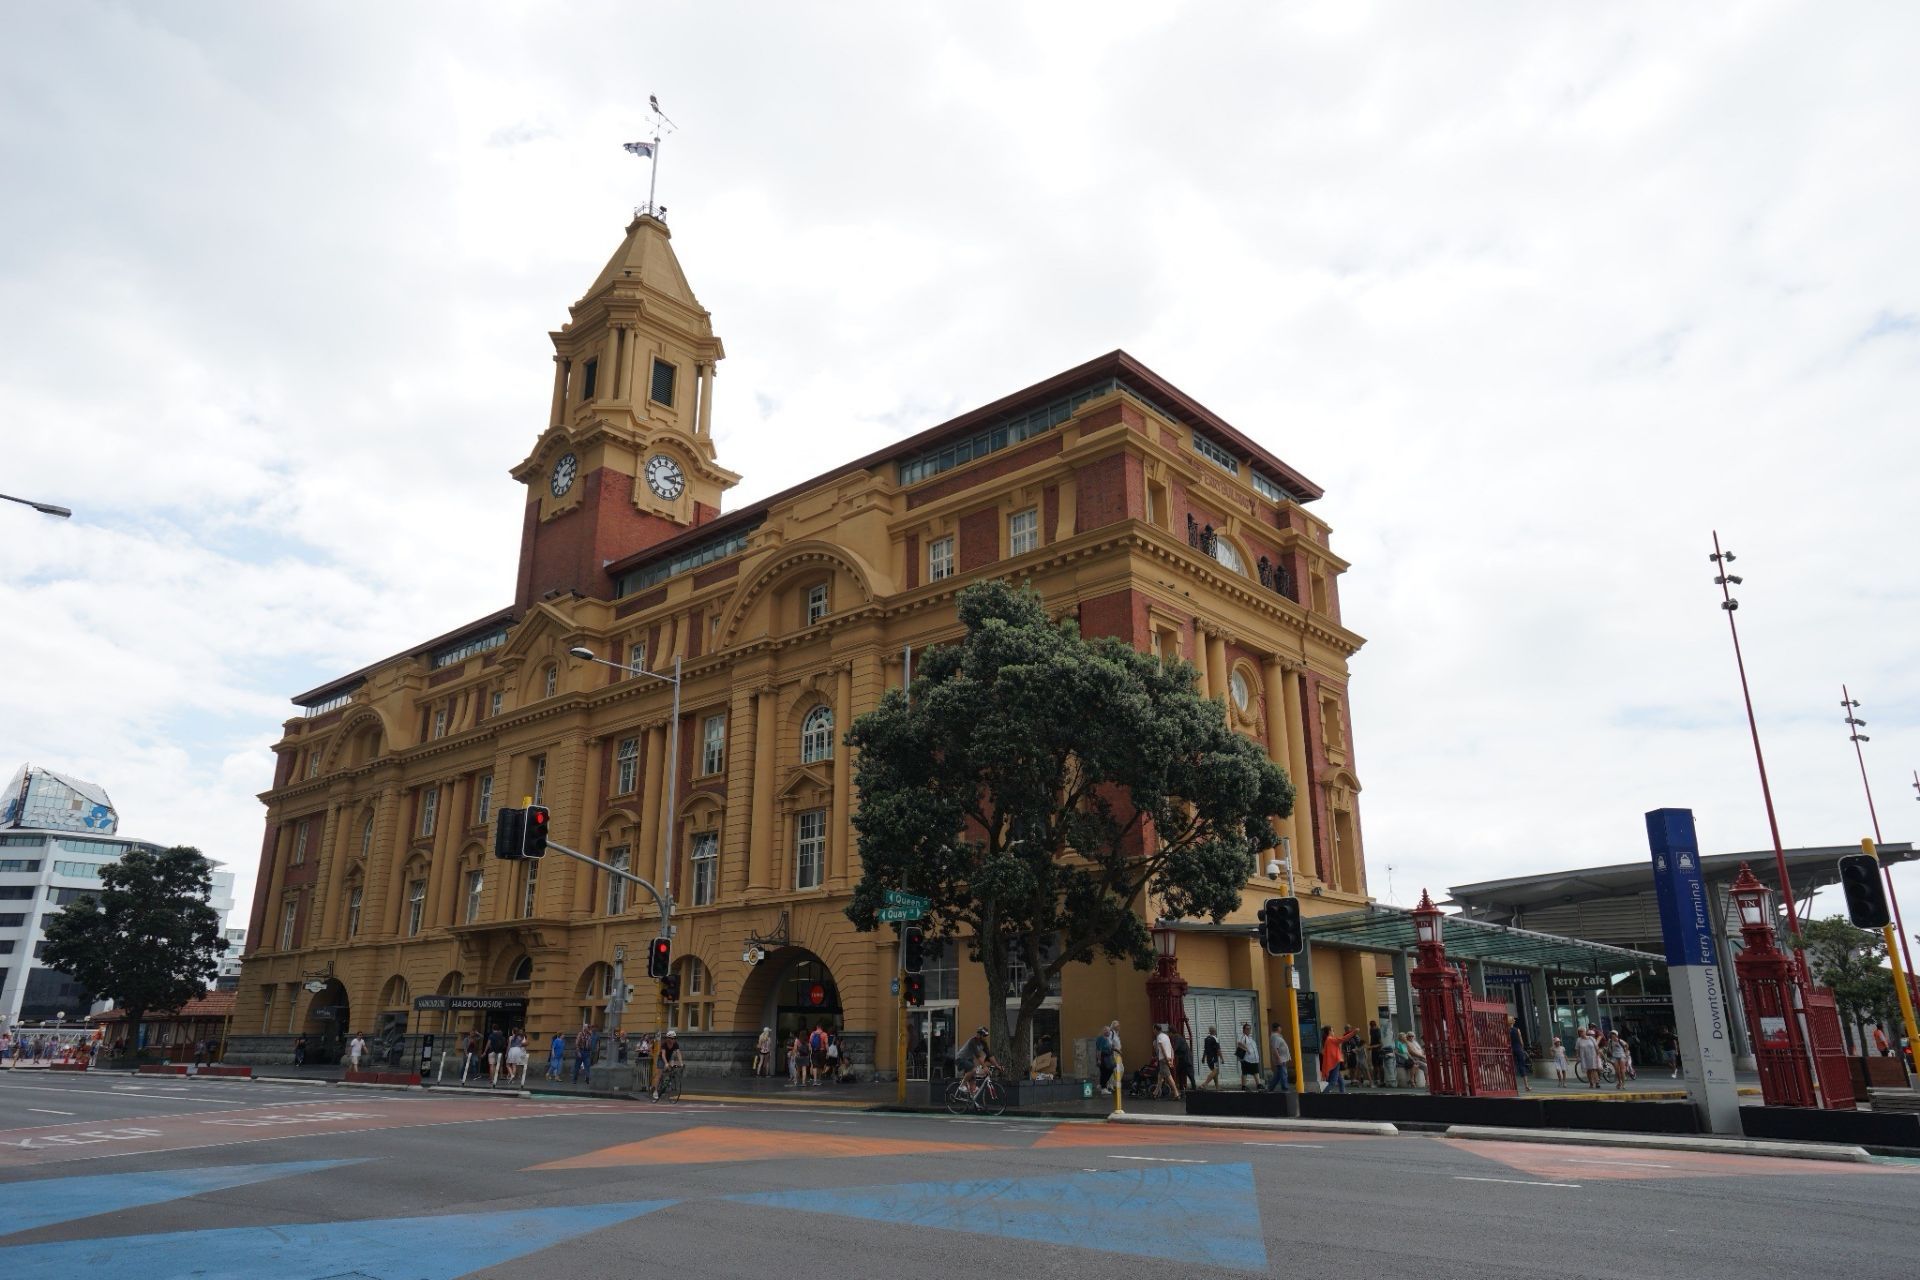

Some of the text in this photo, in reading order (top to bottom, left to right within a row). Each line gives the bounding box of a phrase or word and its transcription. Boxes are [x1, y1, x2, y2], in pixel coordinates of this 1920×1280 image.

[896, 894, 920, 907] Queen
[1688, 879, 1706, 930] Terminal
[887, 910, 907, 919] Quay
[1701, 934, 1711, 963] Ferry
[1552, 976, 1606, 986] Ferry Cafe
[451, 1000, 502, 1009] HARBOURSIDE
[1705, 968, 1722, 1039] Downtown
